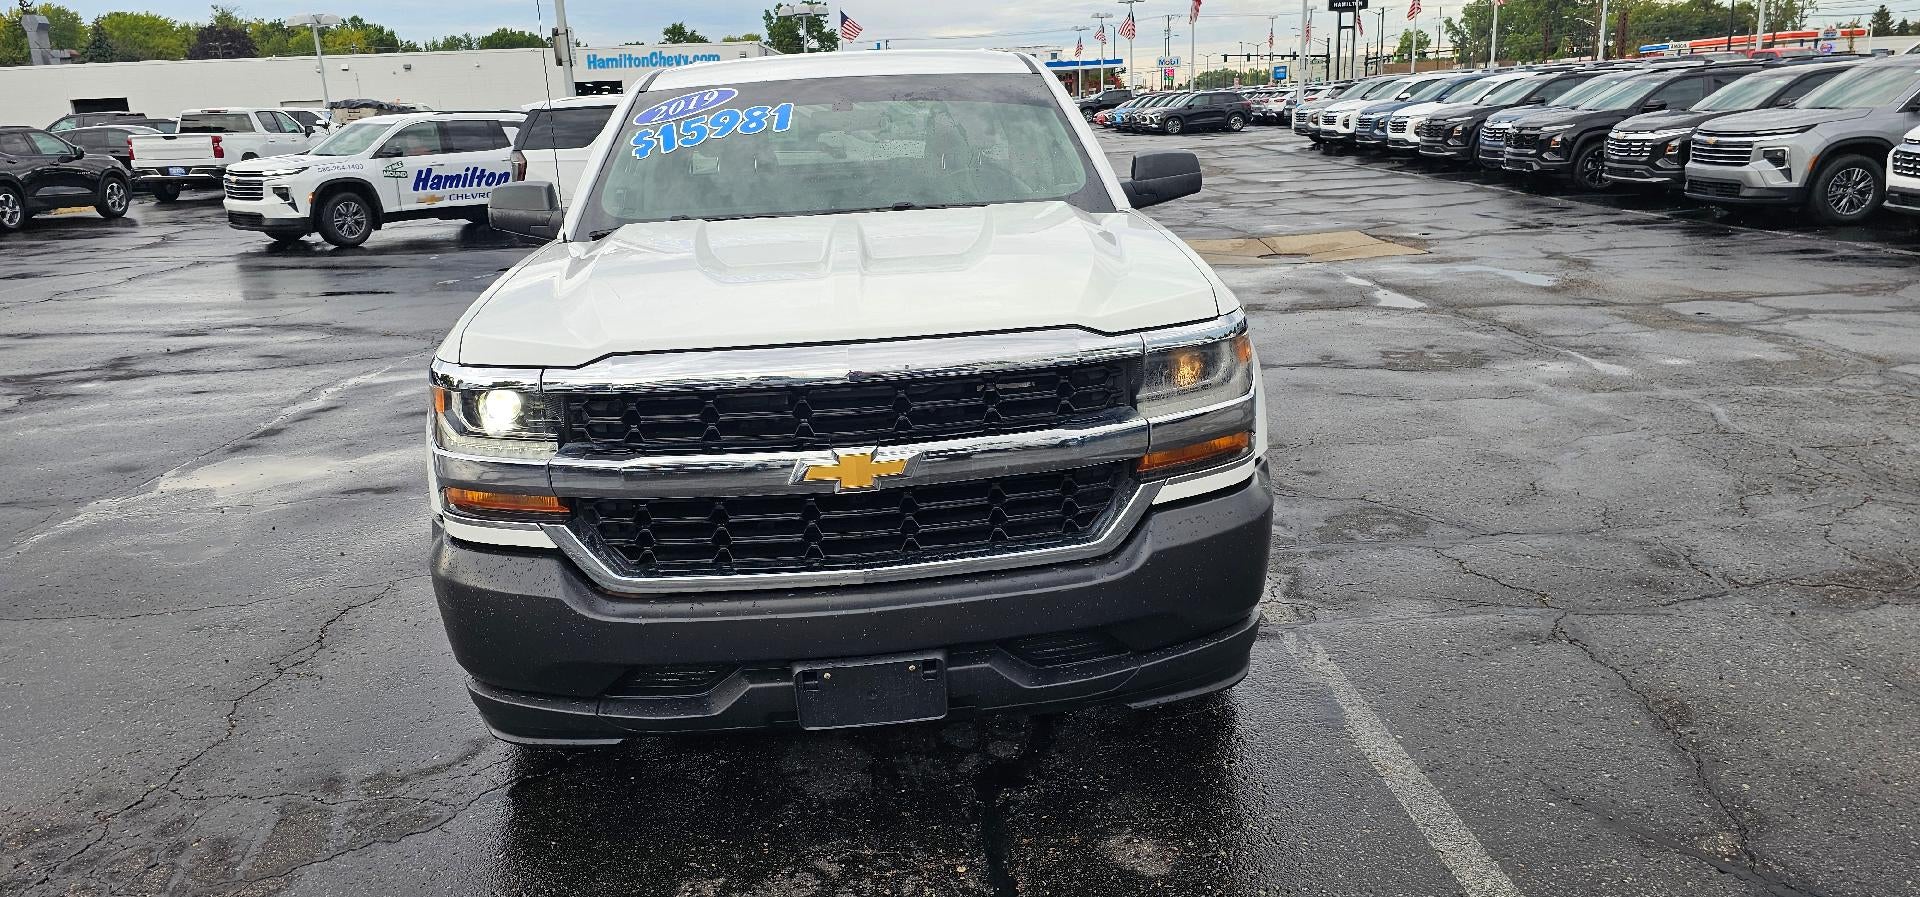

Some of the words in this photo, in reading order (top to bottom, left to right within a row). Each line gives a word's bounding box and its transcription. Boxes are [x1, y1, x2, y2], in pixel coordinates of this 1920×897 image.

[587, 51, 721, 69] HamiltonChevy.com
[652, 90, 719, 121] 2019
[630, 102, 794, 159] $15981
[412, 166, 511, 191] Hamilton
